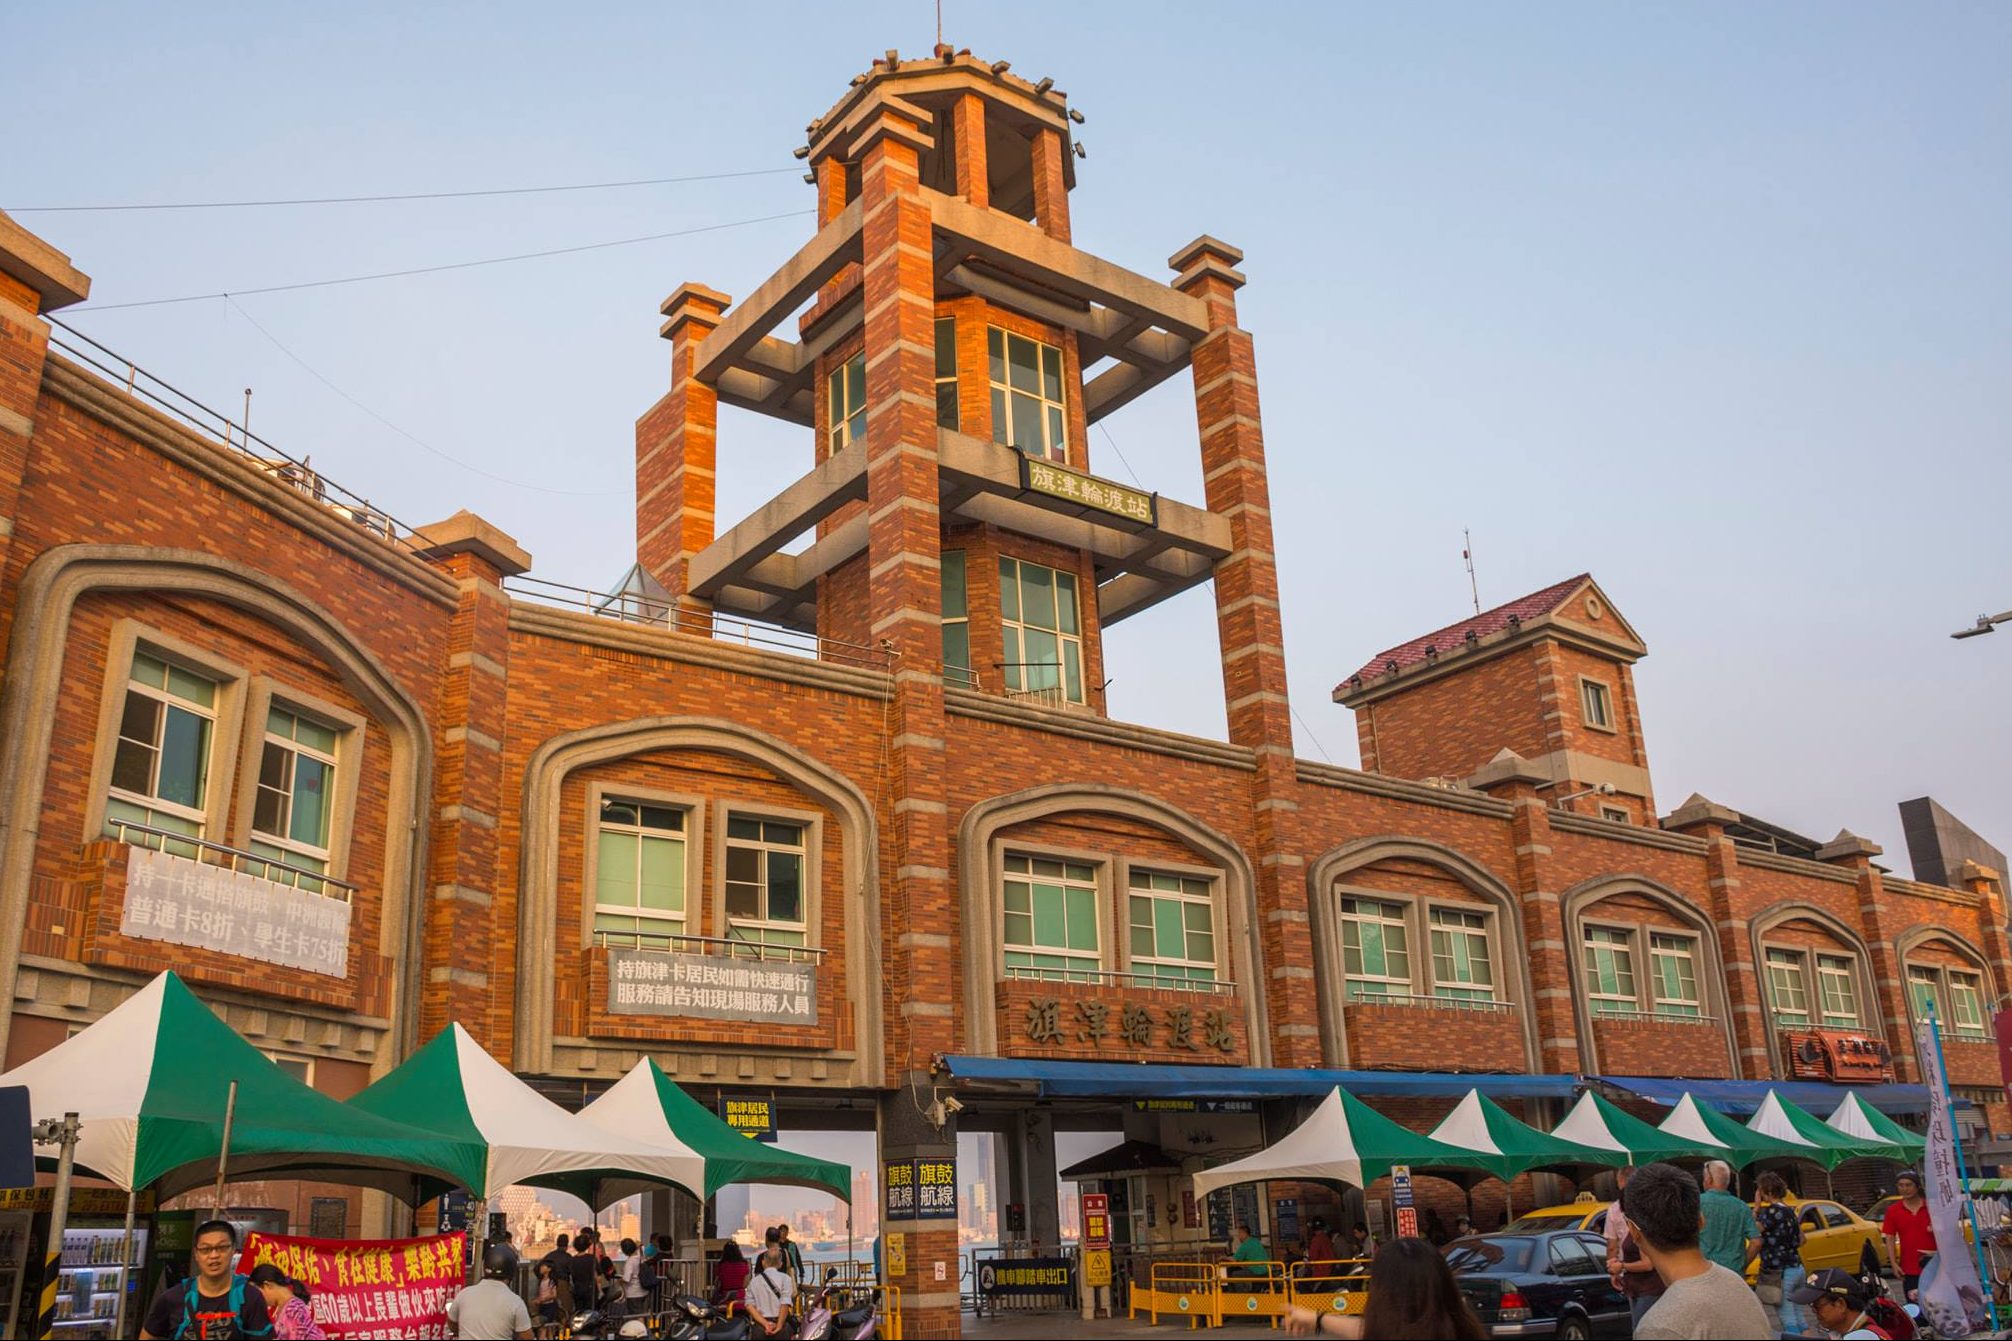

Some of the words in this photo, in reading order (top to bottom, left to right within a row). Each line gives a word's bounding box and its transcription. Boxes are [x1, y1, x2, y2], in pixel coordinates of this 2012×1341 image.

[1033, 466, 1148, 518] 旗津輪渡站
[129, 896, 345, 966] 普通卡8折、學生卡75折
[617, 959, 810, 993] 持旗津卡居民如需快速通行
[617, 982, 810, 1015] 服務請告知現場服務人員
[1026, 998, 1235, 1052] 旗津輪渡站
[888, 1165, 913, 1185] 旗鼓
[919, 1163, 953, 1185] 旗鼓
[889, 1186, 914, 1207] 航線
[920, 1185, 954, 1207] 航線
